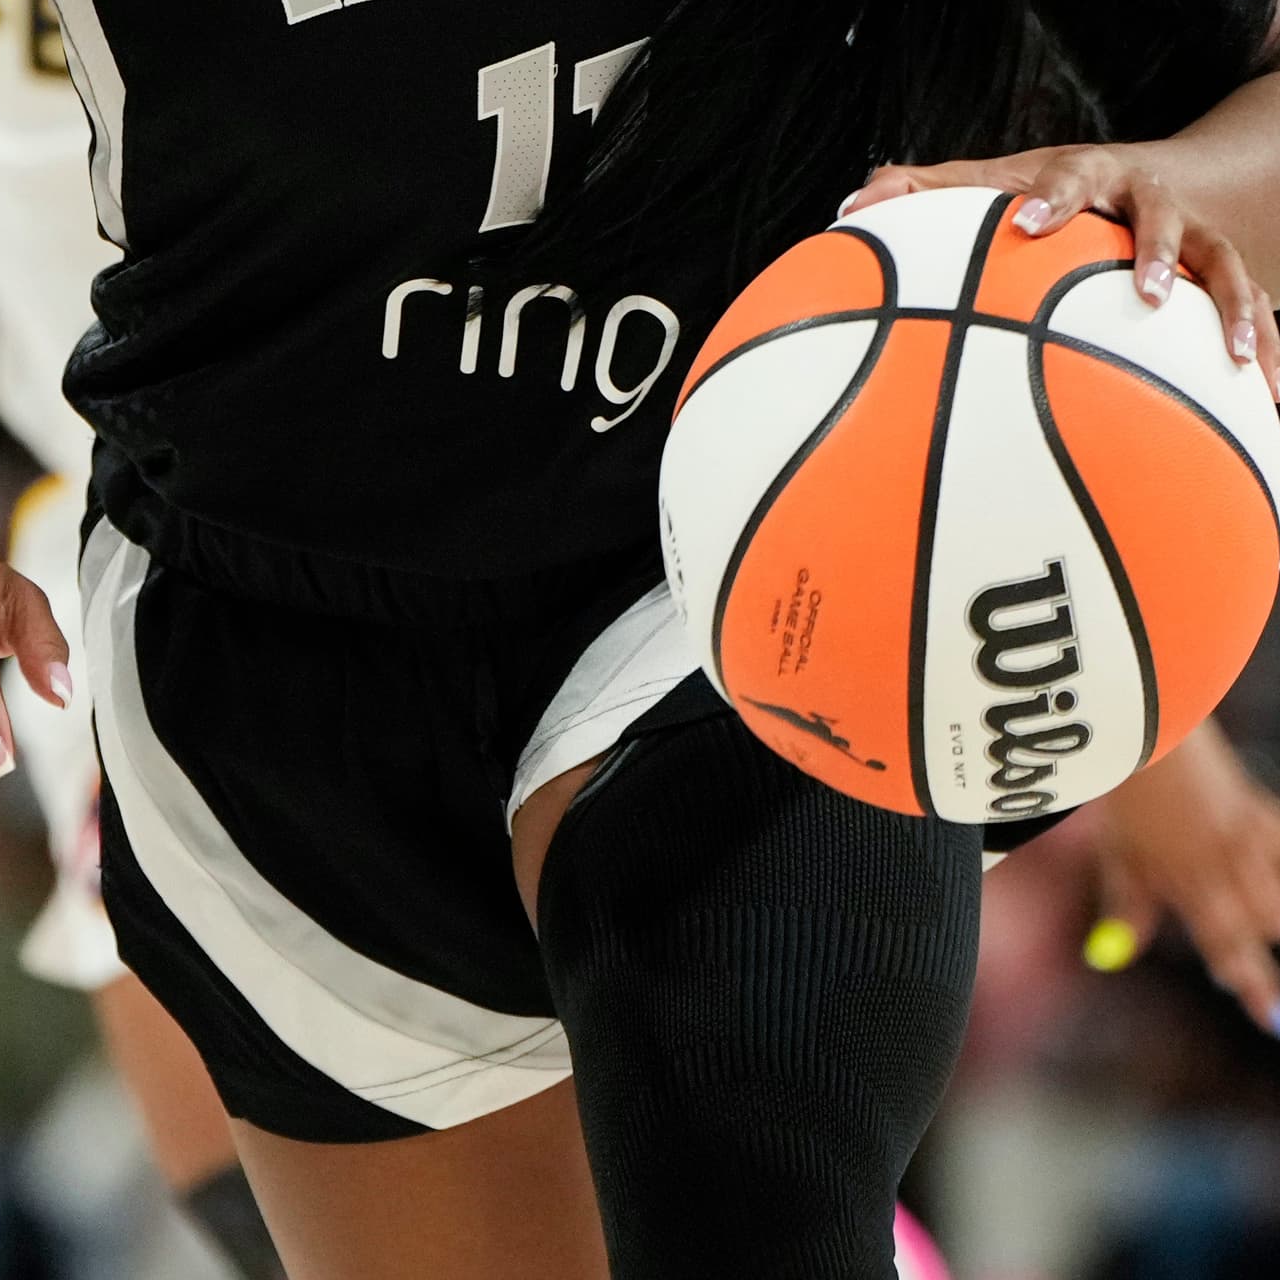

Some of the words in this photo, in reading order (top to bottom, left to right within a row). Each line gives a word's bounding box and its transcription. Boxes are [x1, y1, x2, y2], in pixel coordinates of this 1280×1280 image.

[381, 276, 680, 433] ring
[785, 567, 810, 630] GAME
[777, 630, 795, 677] BALL
[964, 556, 1094, 820] Wilso
[949, 723, 964, 756] EVO
